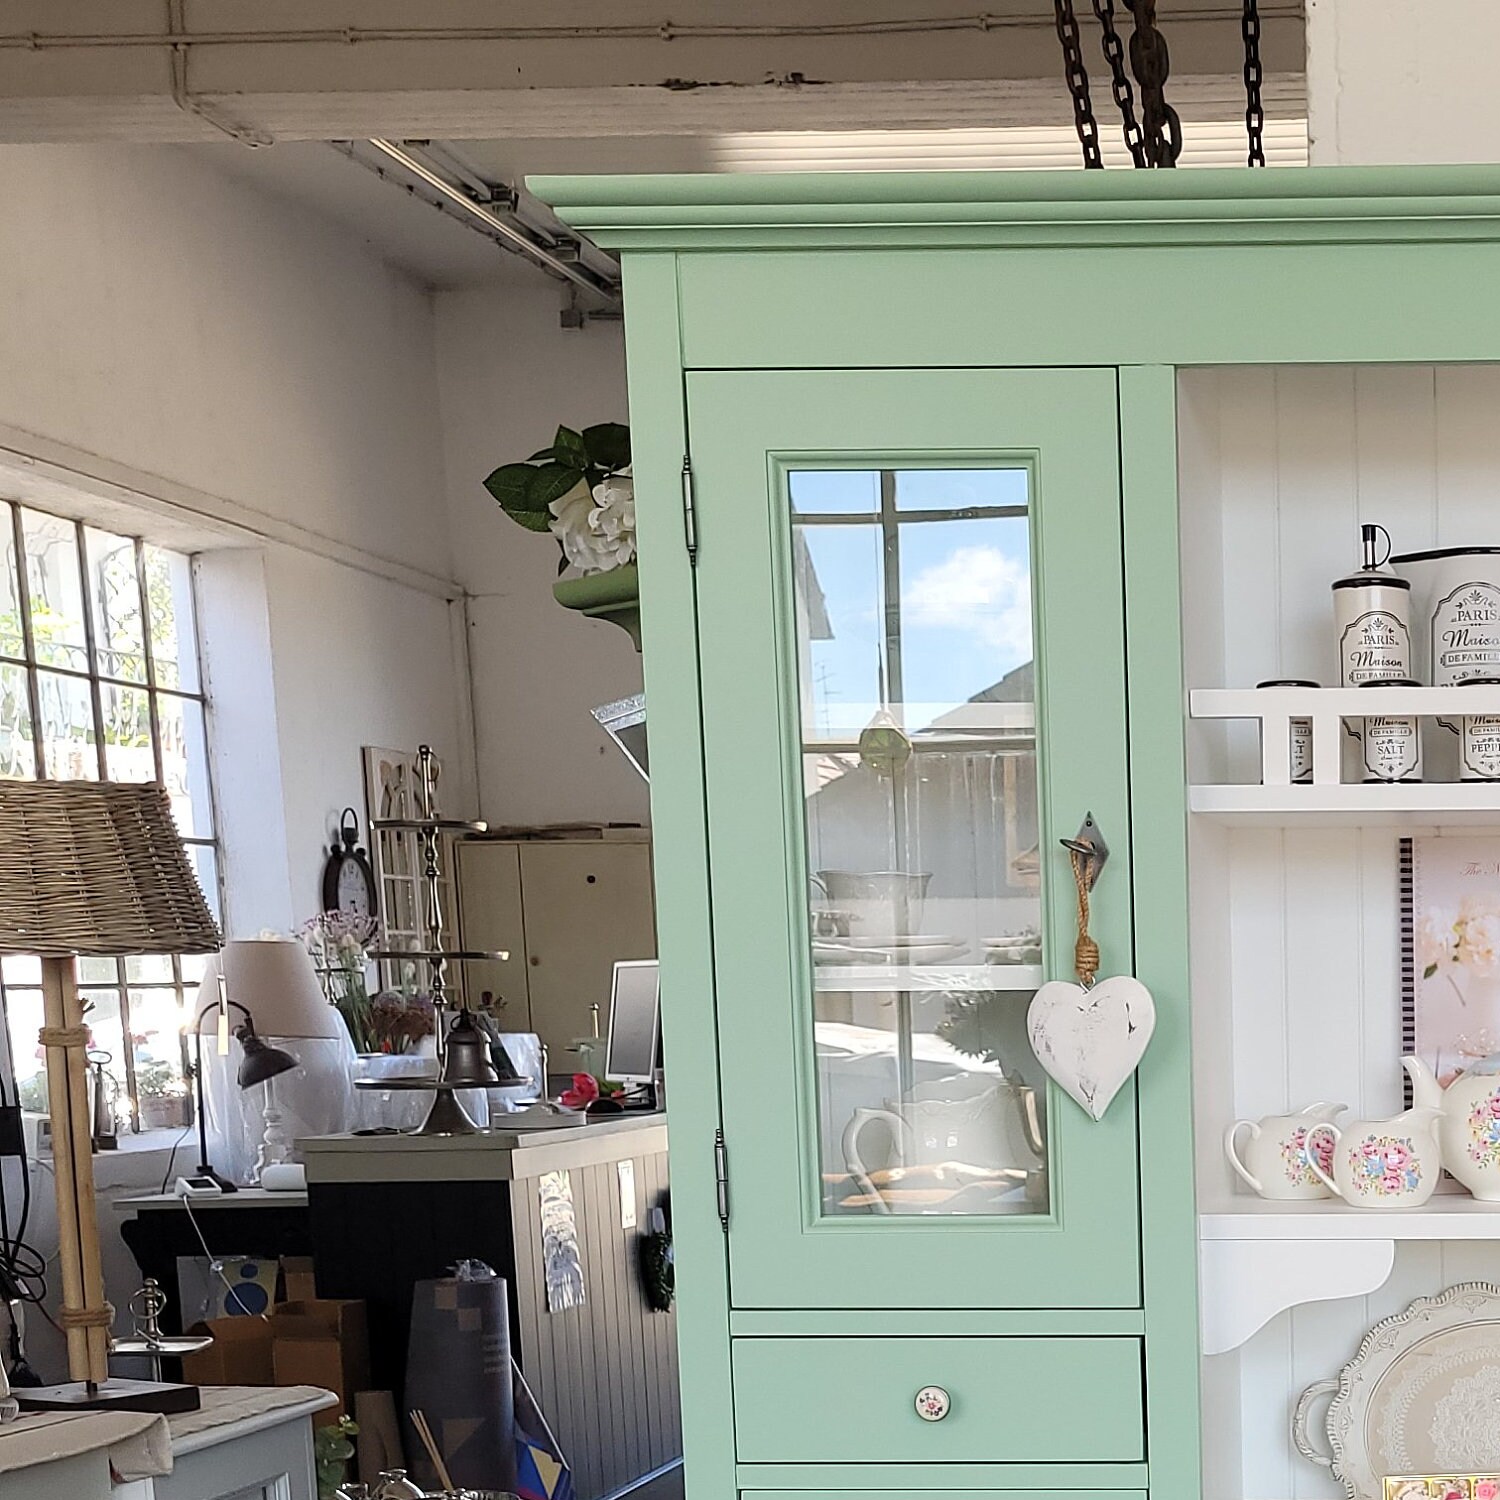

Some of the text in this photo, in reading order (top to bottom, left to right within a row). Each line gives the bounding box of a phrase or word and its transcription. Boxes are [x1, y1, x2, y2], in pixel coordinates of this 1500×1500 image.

[1457, 609, 1498, 621] PARIS
[1363, 635, 1395, 645] PARIS
[1350, 651, 1402, 667] Maison
[1448, 654, 1460, 663] DE
[1377, 745, 1405, 754] SALT
[1461, 861, 1482, 877] The
